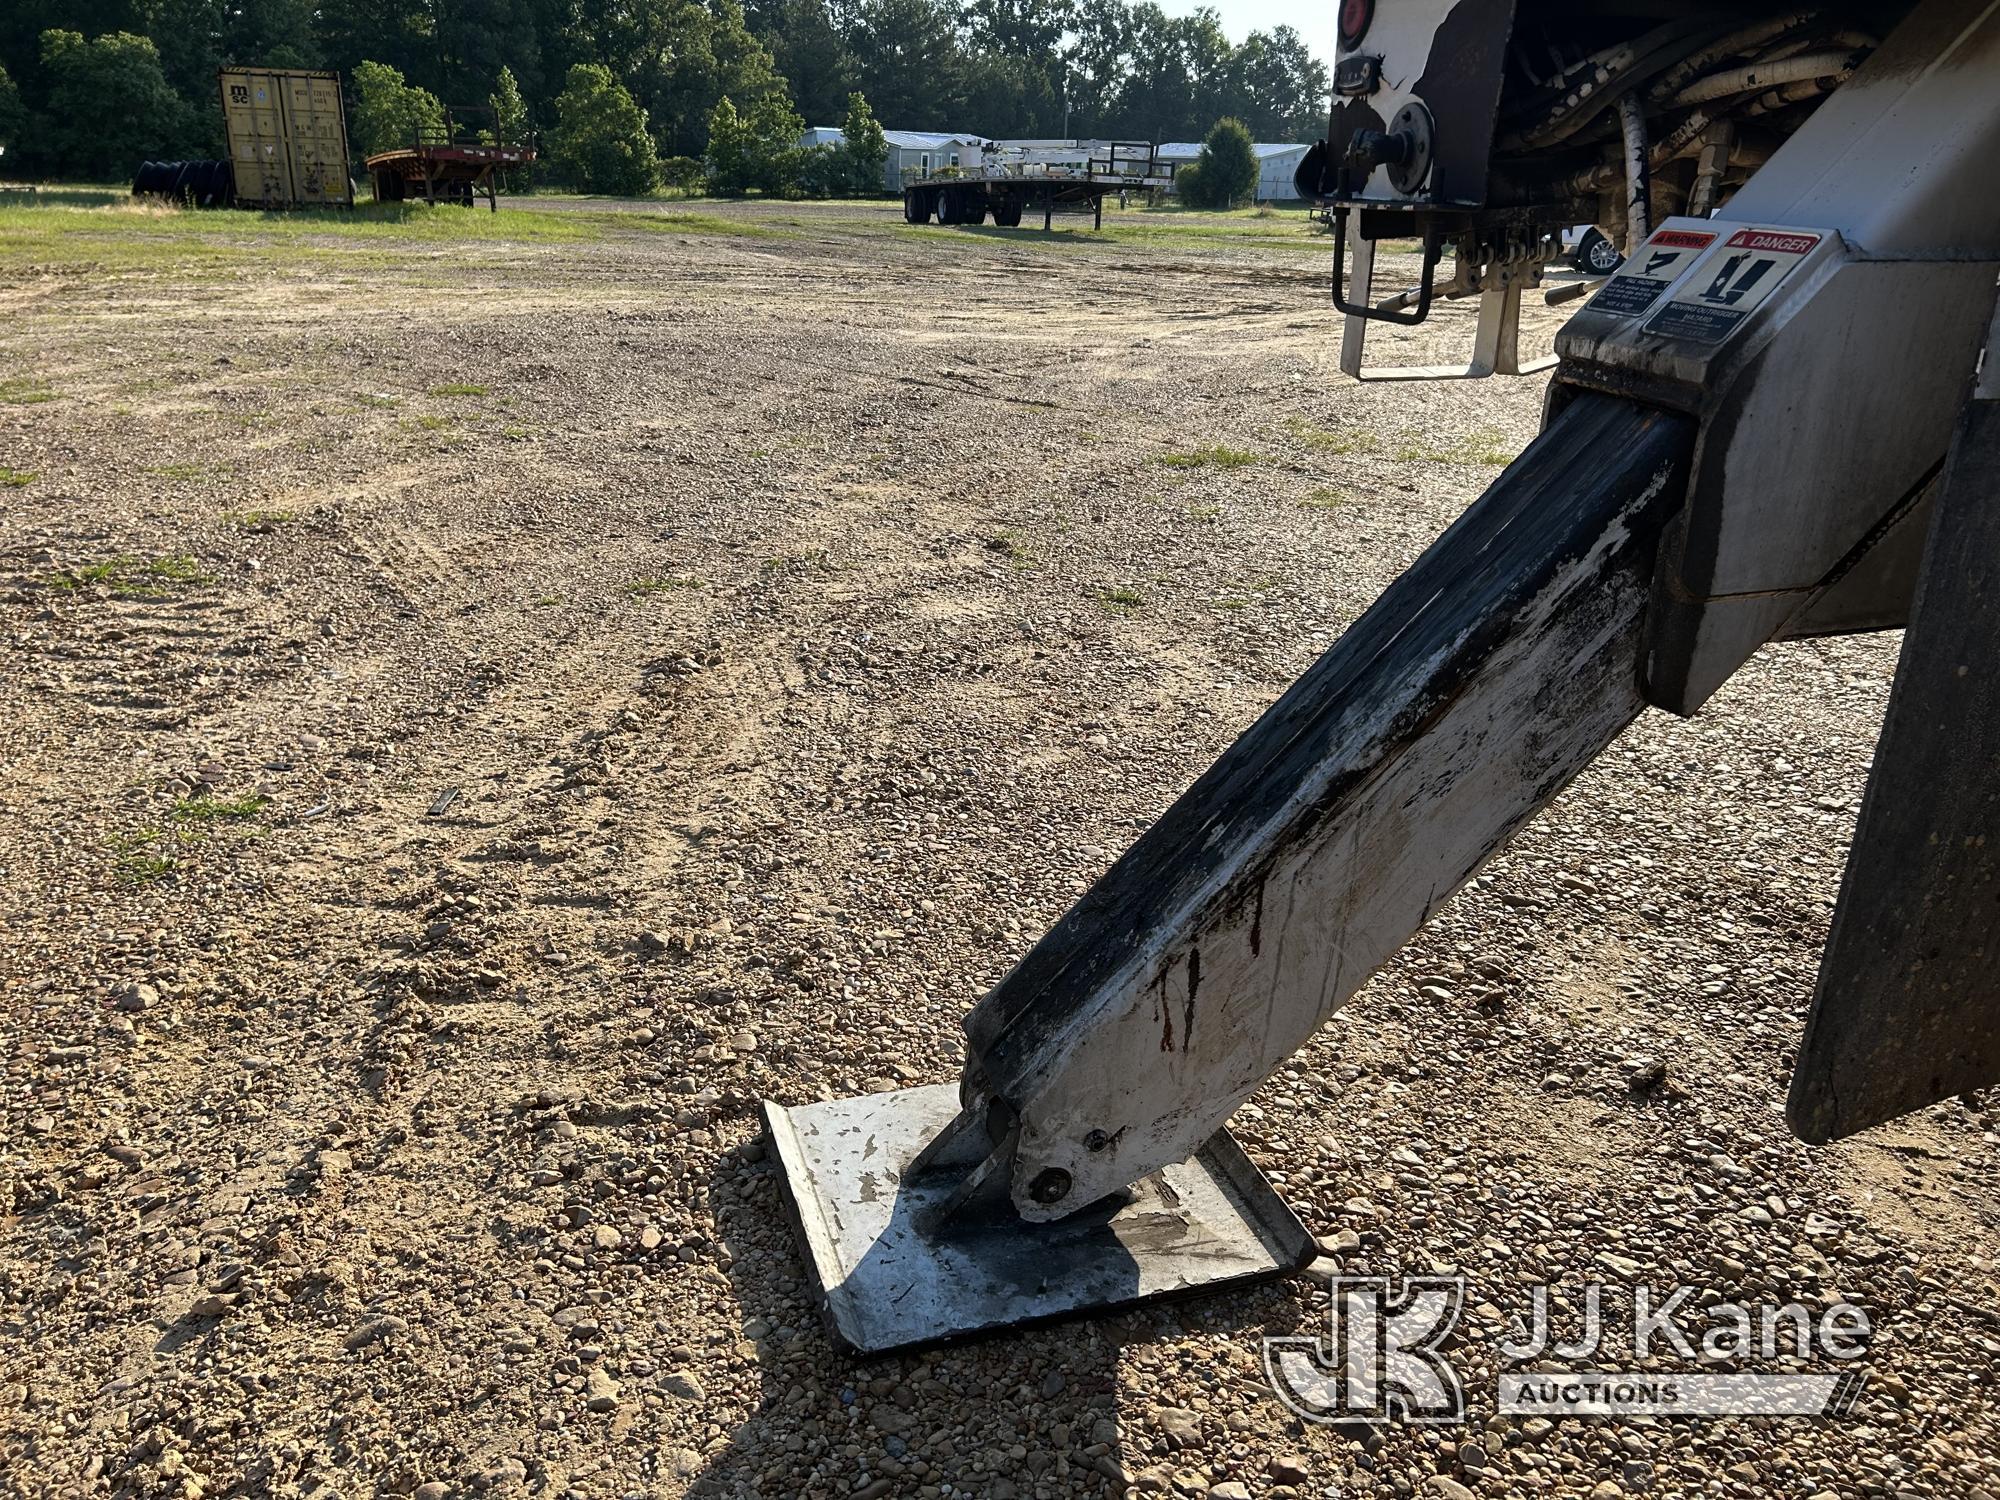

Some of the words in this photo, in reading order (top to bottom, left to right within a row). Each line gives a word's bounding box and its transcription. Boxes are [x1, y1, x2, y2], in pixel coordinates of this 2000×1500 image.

[1664, 235, 1710, 247] WARNING
[1749, 236, 1811, 251] DANGER
[1670, 303, 1697, 313] MOVING
[1696, 307, 1740, 319] OUTRIGGER
